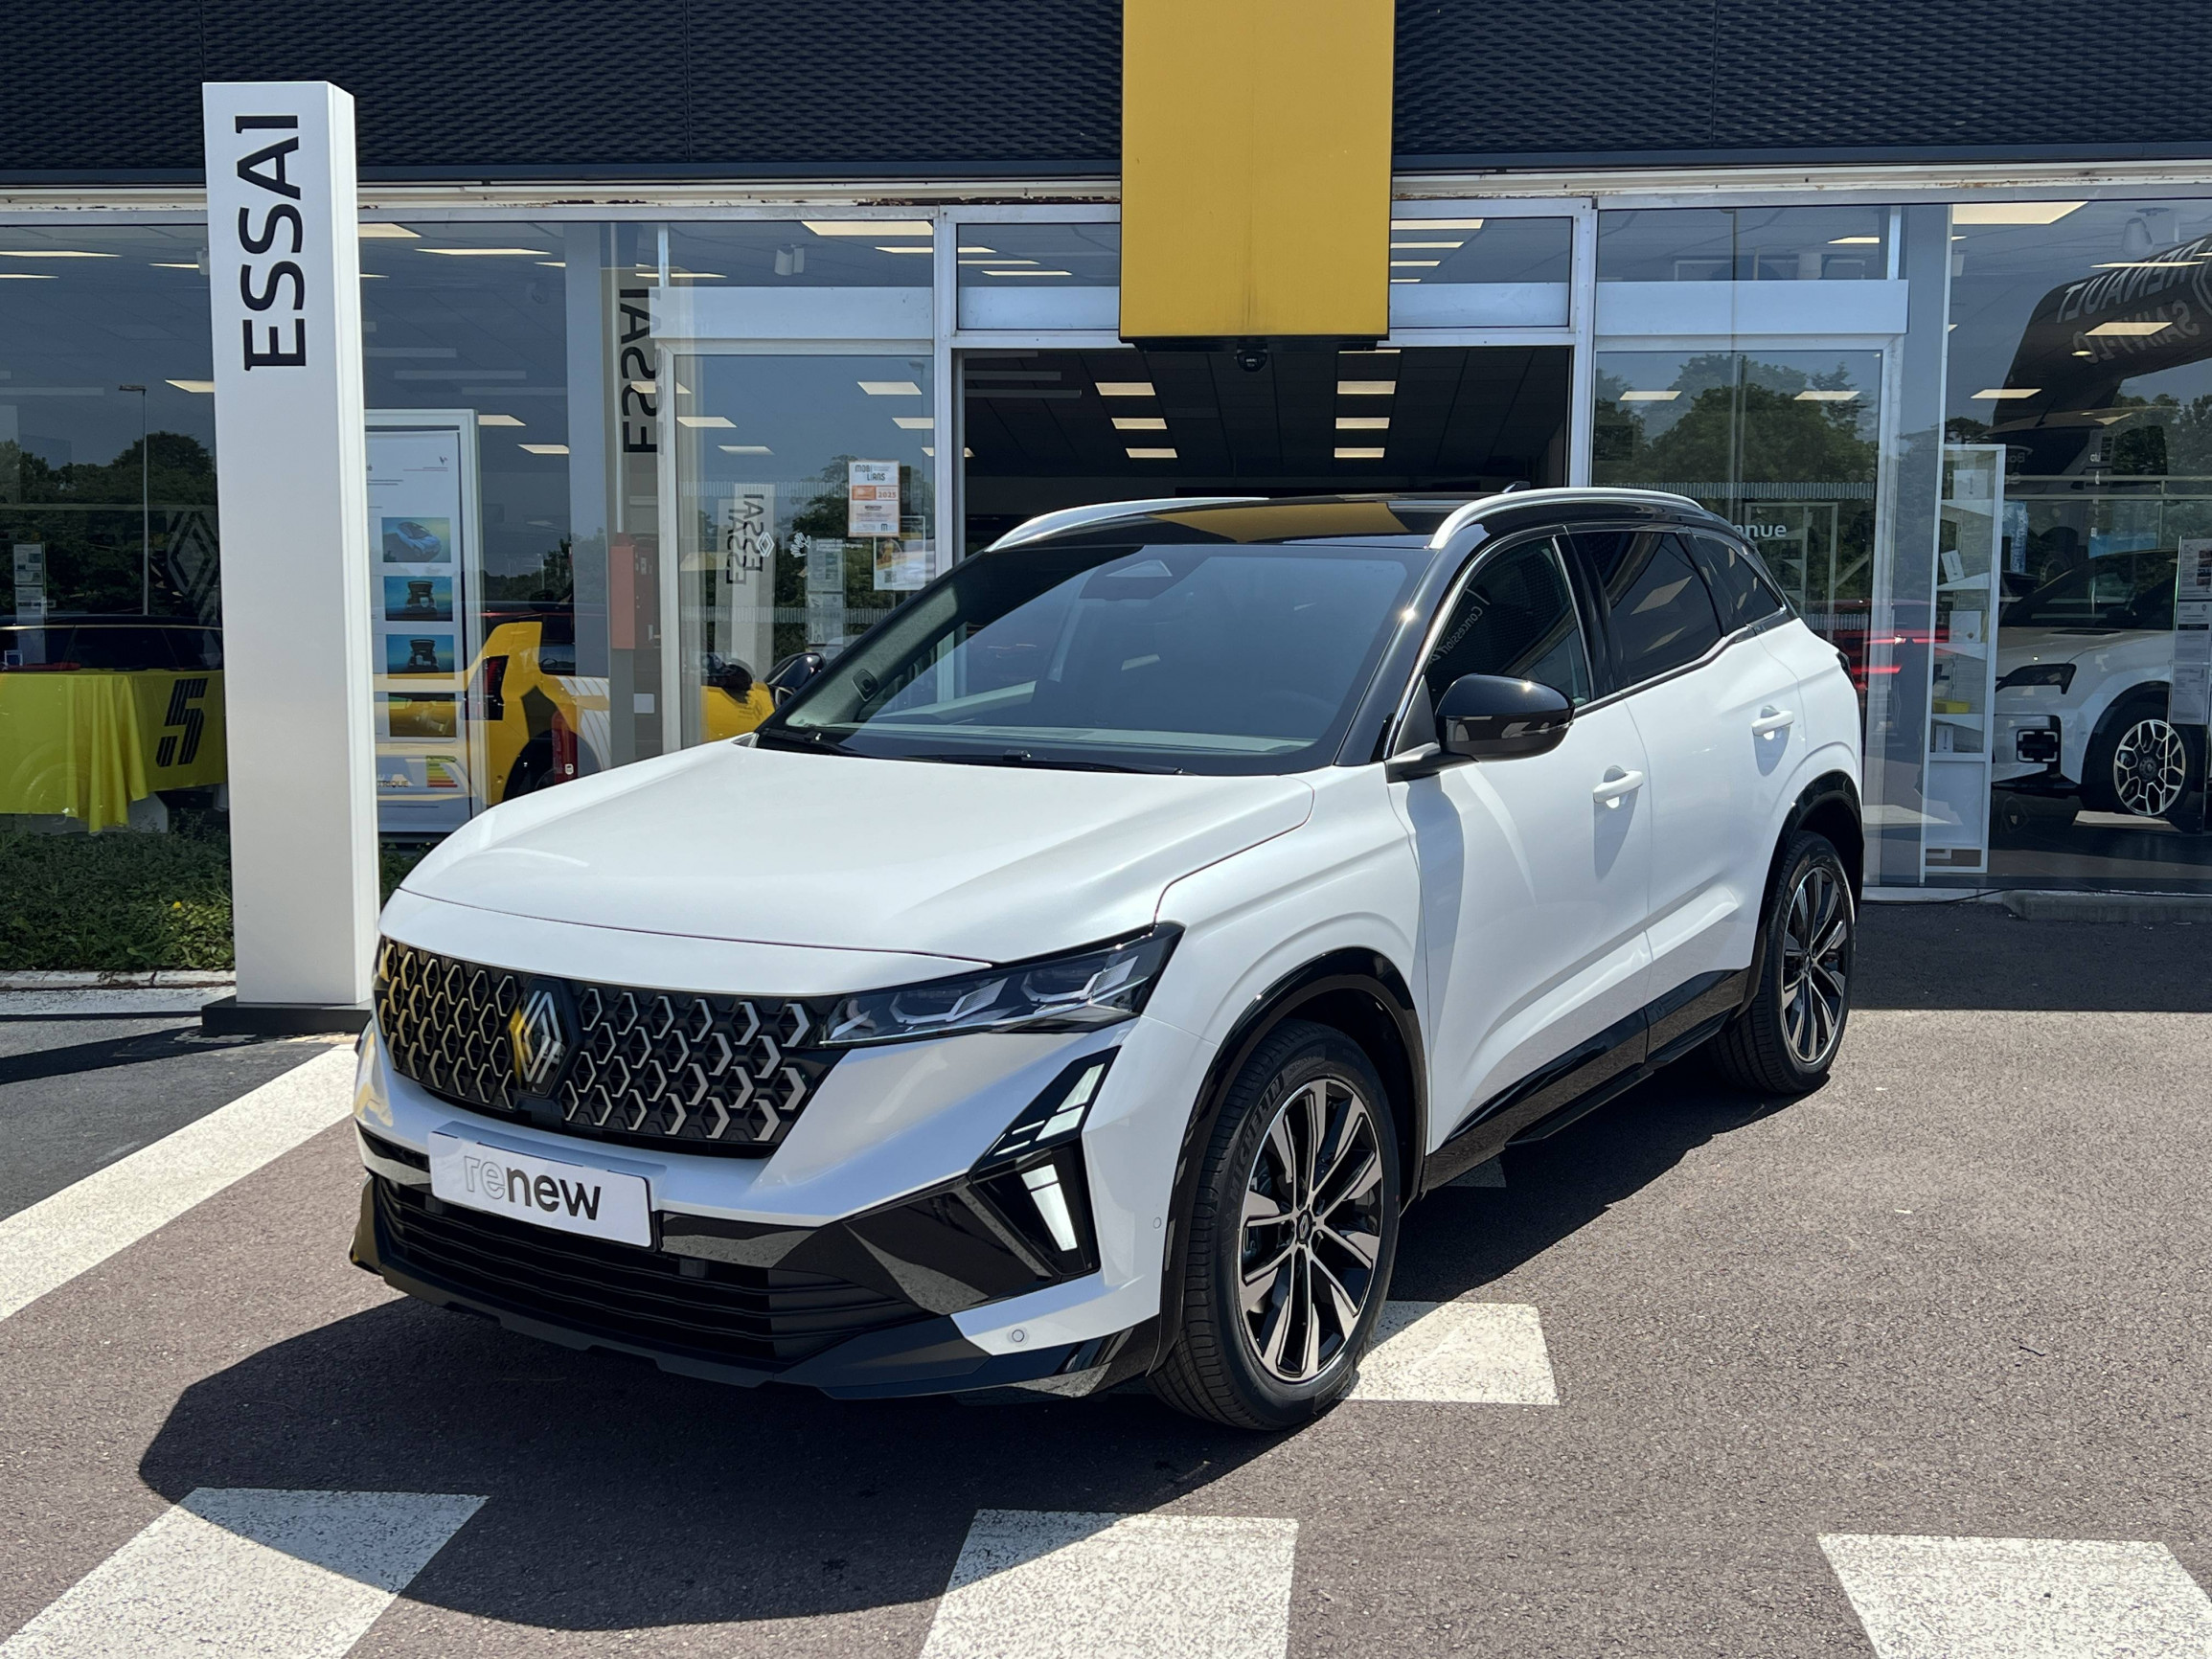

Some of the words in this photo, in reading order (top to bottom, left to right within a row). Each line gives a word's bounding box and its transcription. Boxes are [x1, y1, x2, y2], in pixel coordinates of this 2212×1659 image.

[235, 114, 307, 372] ESSAI
[155, 677, 209, 767] 5
[464, 1155, 602, 1221] renew
[1229, 1071, 1284, 1203] MICHELIN
